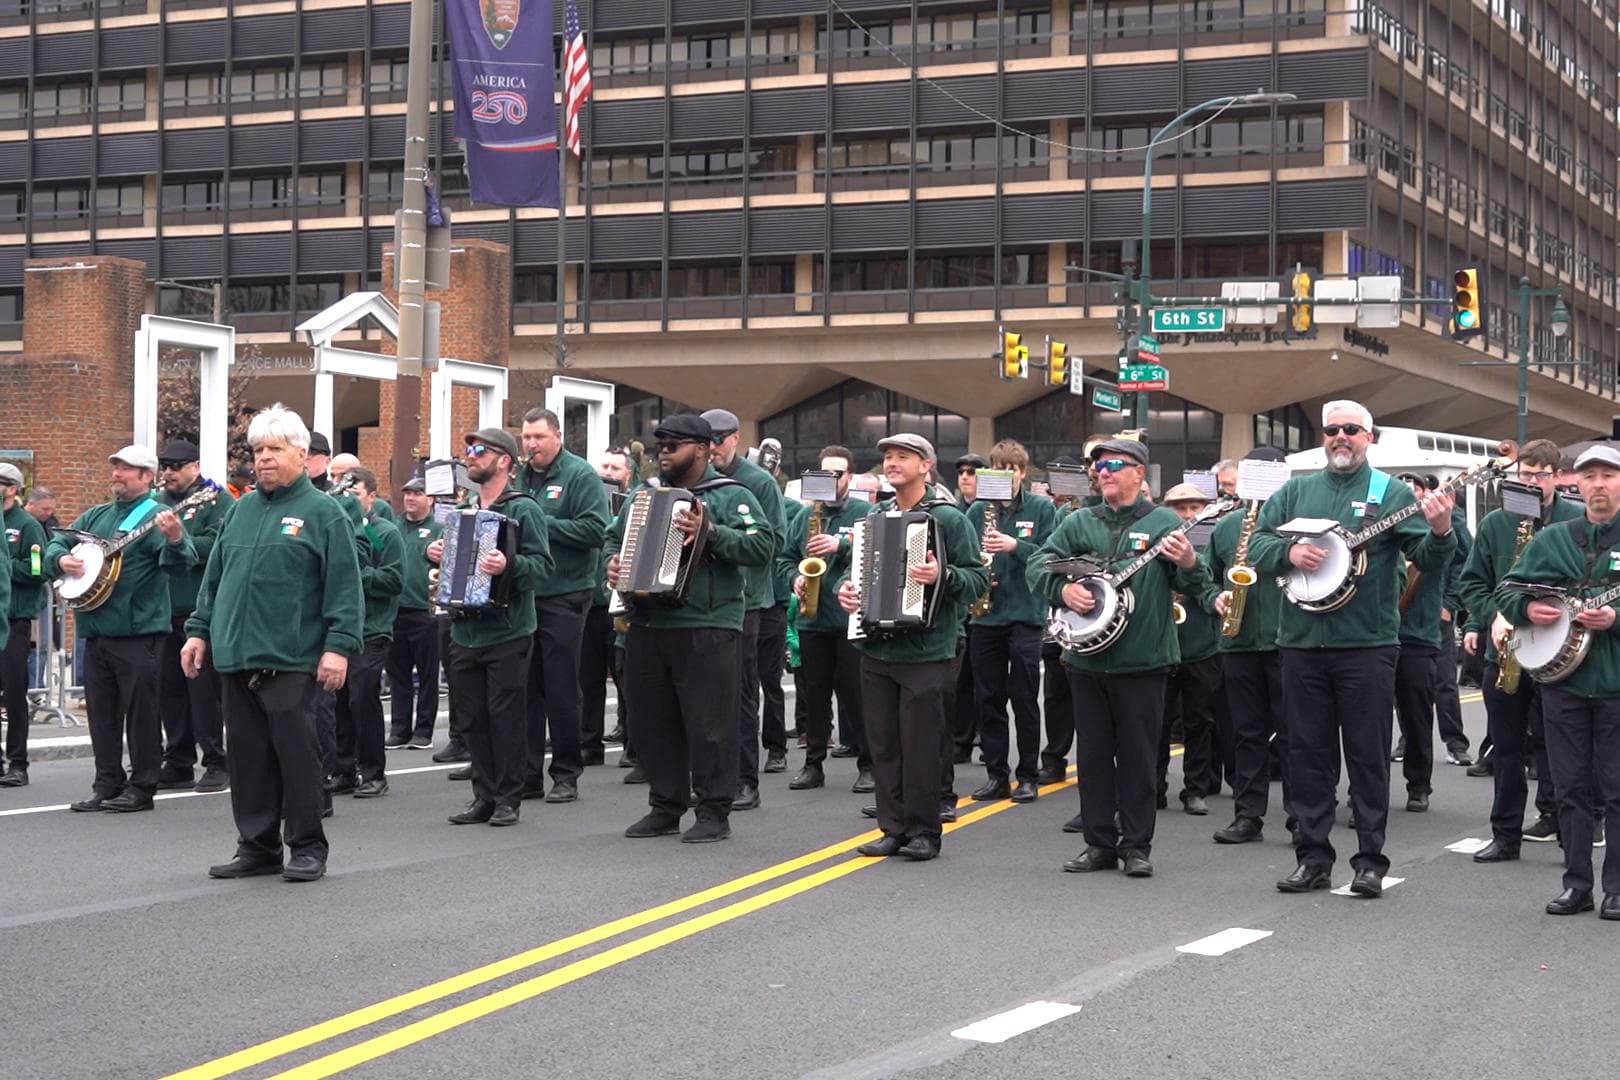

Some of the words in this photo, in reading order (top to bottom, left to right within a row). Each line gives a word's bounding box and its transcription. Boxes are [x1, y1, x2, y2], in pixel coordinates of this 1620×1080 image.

[472, 74, 526, 89] AMERICA
[472, 90, 528, 124] 250
[1161, 311, 1190, 326] 6th
[1197, 311, 1216, 326] St
[274, 356, 304, 369] MALL
